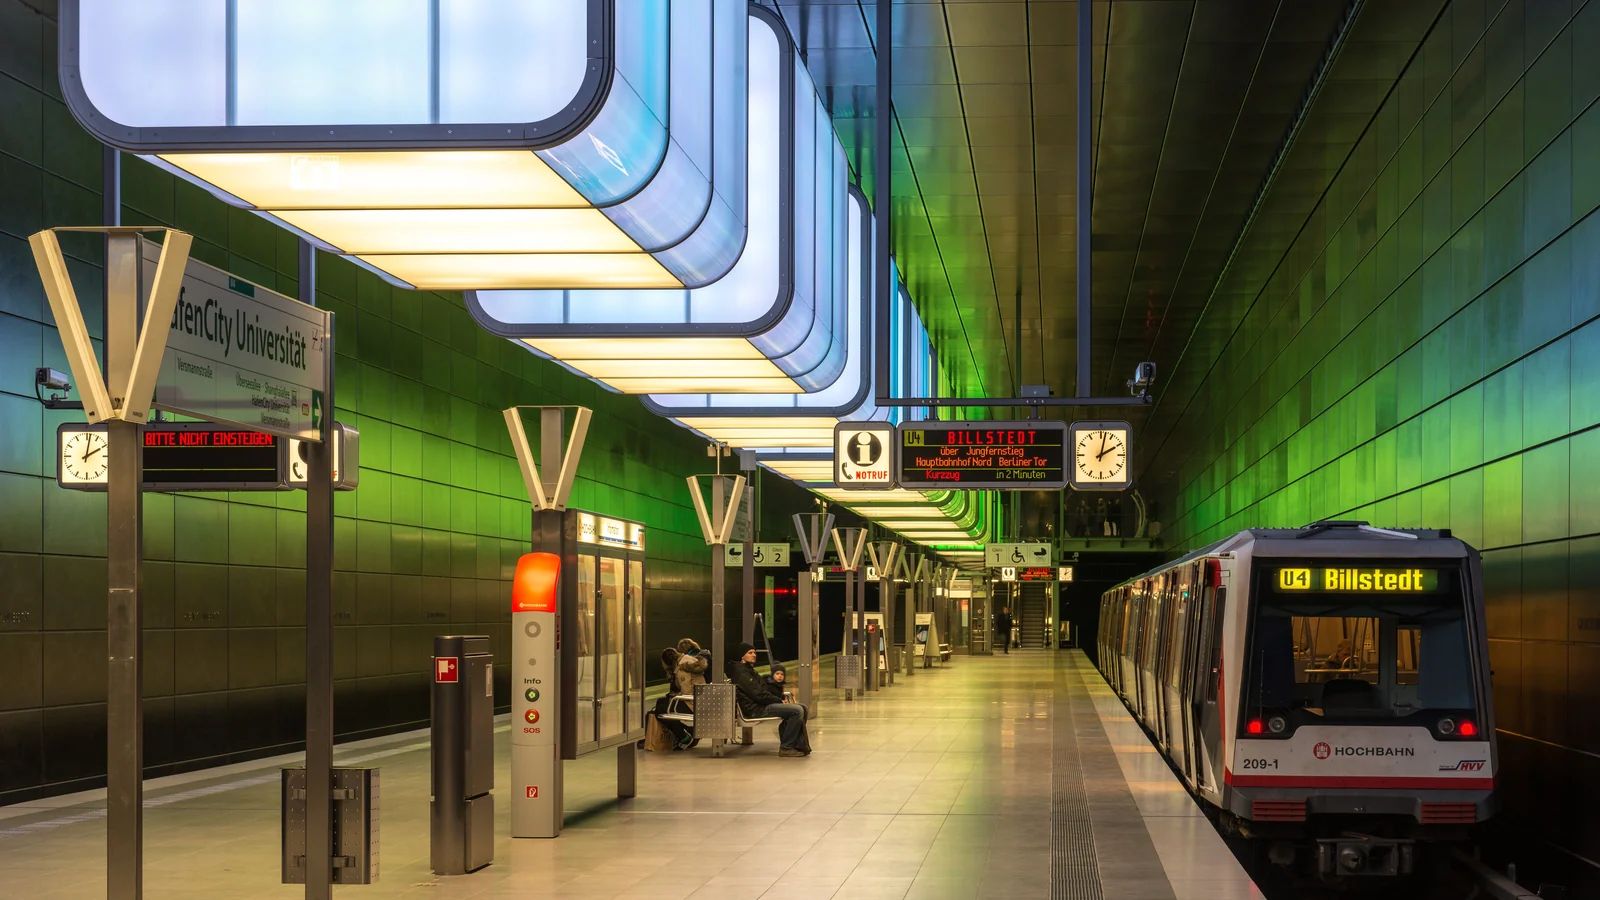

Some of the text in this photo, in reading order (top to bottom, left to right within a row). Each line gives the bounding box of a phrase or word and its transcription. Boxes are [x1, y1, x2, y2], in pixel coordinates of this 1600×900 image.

[170, 286, 307, 371] afenCity Universität
[177, 356, 213, 379] Versmannstraße
[145, 432, 273, 446] BITTE NICHT EINSTEIGEN
[907, 431, 921, 445] U4
[948, 431, 1036, 445] BILLSTEDT
[940, 446, 1024, 458] über Jungfernstieg
[916, 457, 1048, 468] Hauptbahnhof Nord Berliner Tor
[855, 470, 888, 480] NOTRUF
[925, 470, 960, 481] Kurzzug
[996, 470, 1046, 479] in 2 Minuten
[774, 553, 781, 562] 2
[995, 553, 1000, 562] 1
[1283, 569, 1307, 588] U4
[1325, 568, 1424, 591] Billstedt
[523, 677, 542, 685] Info
[1334, 746, 1415, 757] HOCHBAHN
[1243, 759, 1279, 770] 209-1
[1459, 762, 1485, 771] HVV
